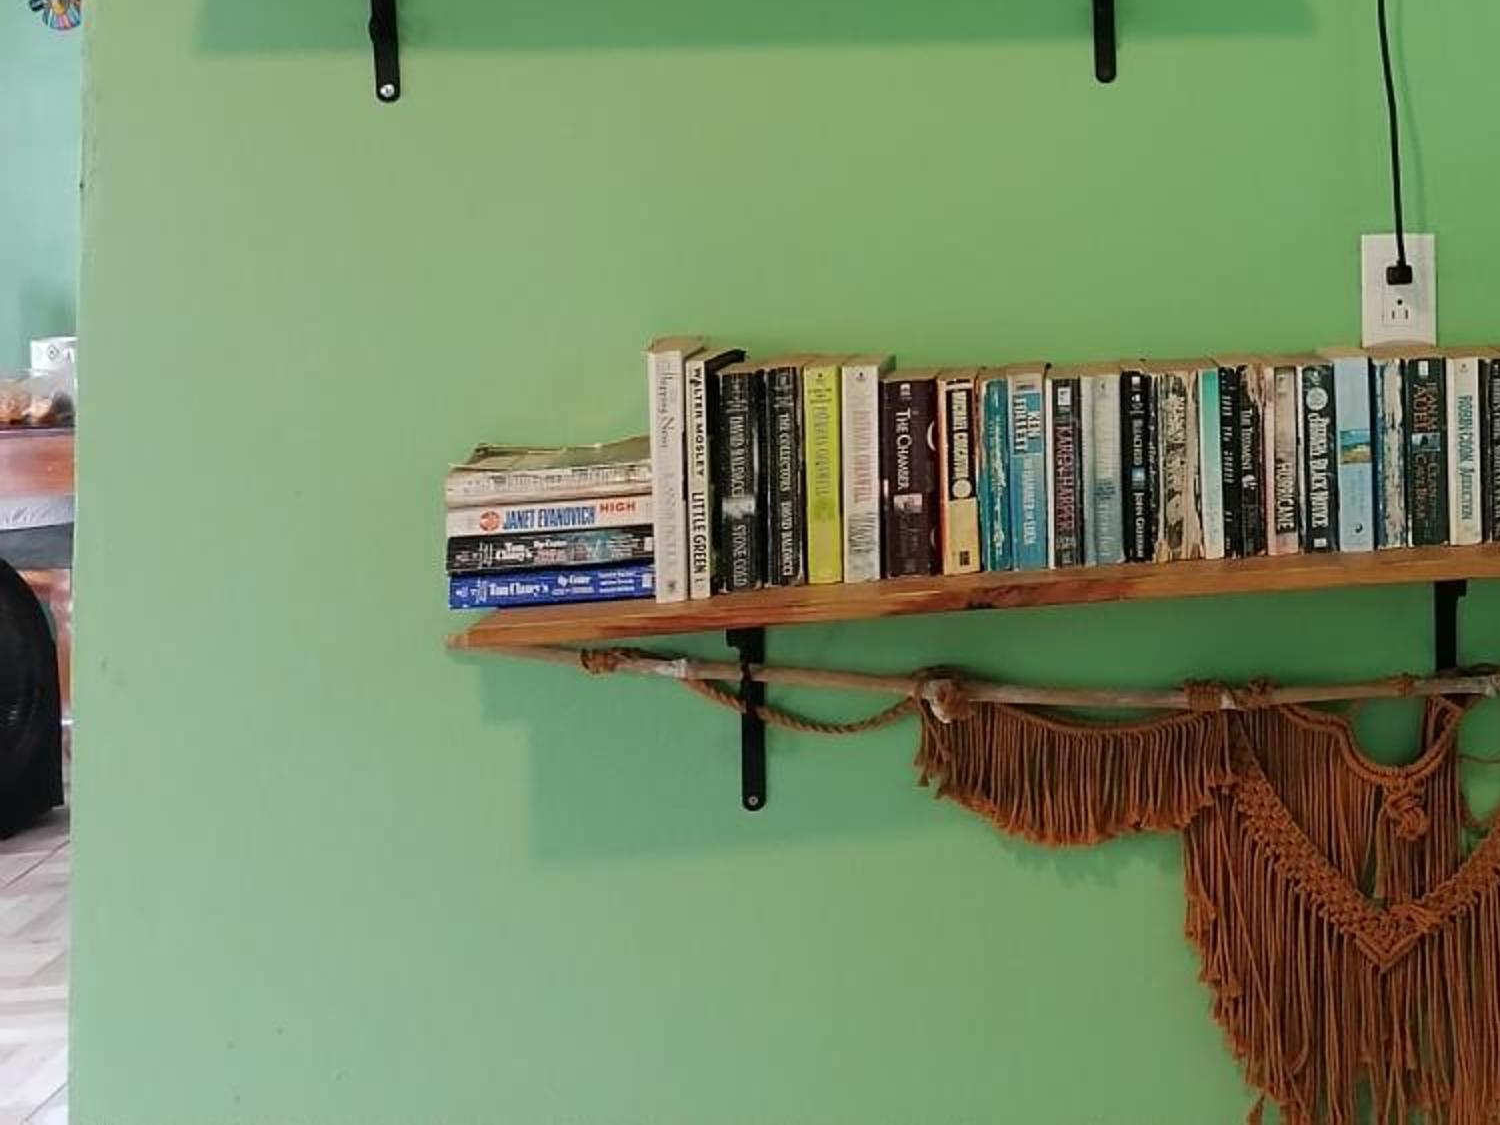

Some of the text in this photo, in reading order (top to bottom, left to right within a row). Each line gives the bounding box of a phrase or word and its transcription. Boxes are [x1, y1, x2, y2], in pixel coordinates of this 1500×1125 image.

[689, 366, 705, 476] WALTER MOSLEY
[951, 391, 969, 480] MICHAEL CRICHTON
[1012, 397, 1028, 451] FOLLETT
[1026, 410, 1041, 437] KEN
[1413, 385, 1428, 432] AUEL
[730, 415, 746, 499] DAVID BALDACCI
[778, 412, 791, 492] THE COLLECTORS
[895, 407, 913, 490] THE CHAMBER
[1056, 425, 1075, 532] KAREN HARPER
[1241, 427, 1253, 471] TESTAMENT
[1458, 394, 1475, 520] ROBIN COOK ABDUCTION
[502, 505, 597, 531] JANET EVANOVICH
[599, 501, 637, 515] HIGH
[1133, 492, 1145, 516] JOHN
[1276, 461, 1295, 531] HURRICANE
[1309, 458, 1329, 528] BLACK NOTICE
[691, 491, 706, 572] LITTLE GREEN
[731, 524, 747, 557] STONE
[780, 500, 794, 577] DAVID BALDACCI
[488, 583, 509, 597] Tom
